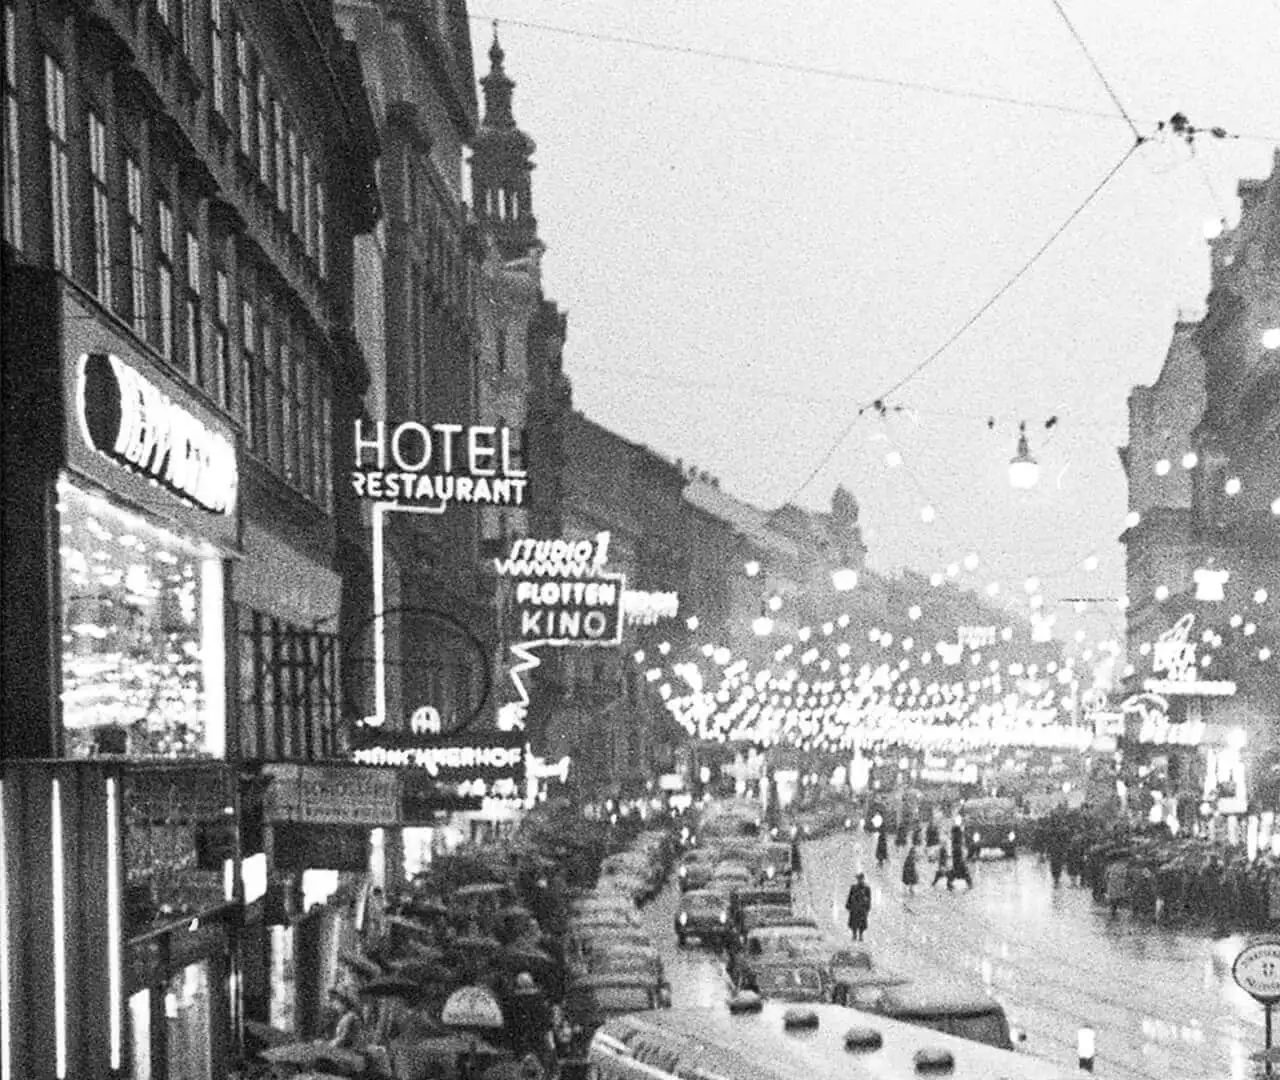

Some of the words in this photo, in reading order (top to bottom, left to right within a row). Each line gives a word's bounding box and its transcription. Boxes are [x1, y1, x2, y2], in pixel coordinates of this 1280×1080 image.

[355, 419, 527, 477] HOTEL
[352, 471, 527, 505] RESTAURANT
[516, 581, 616, 607] FLOTTEN
[521, 610, 606, 638] KINO
